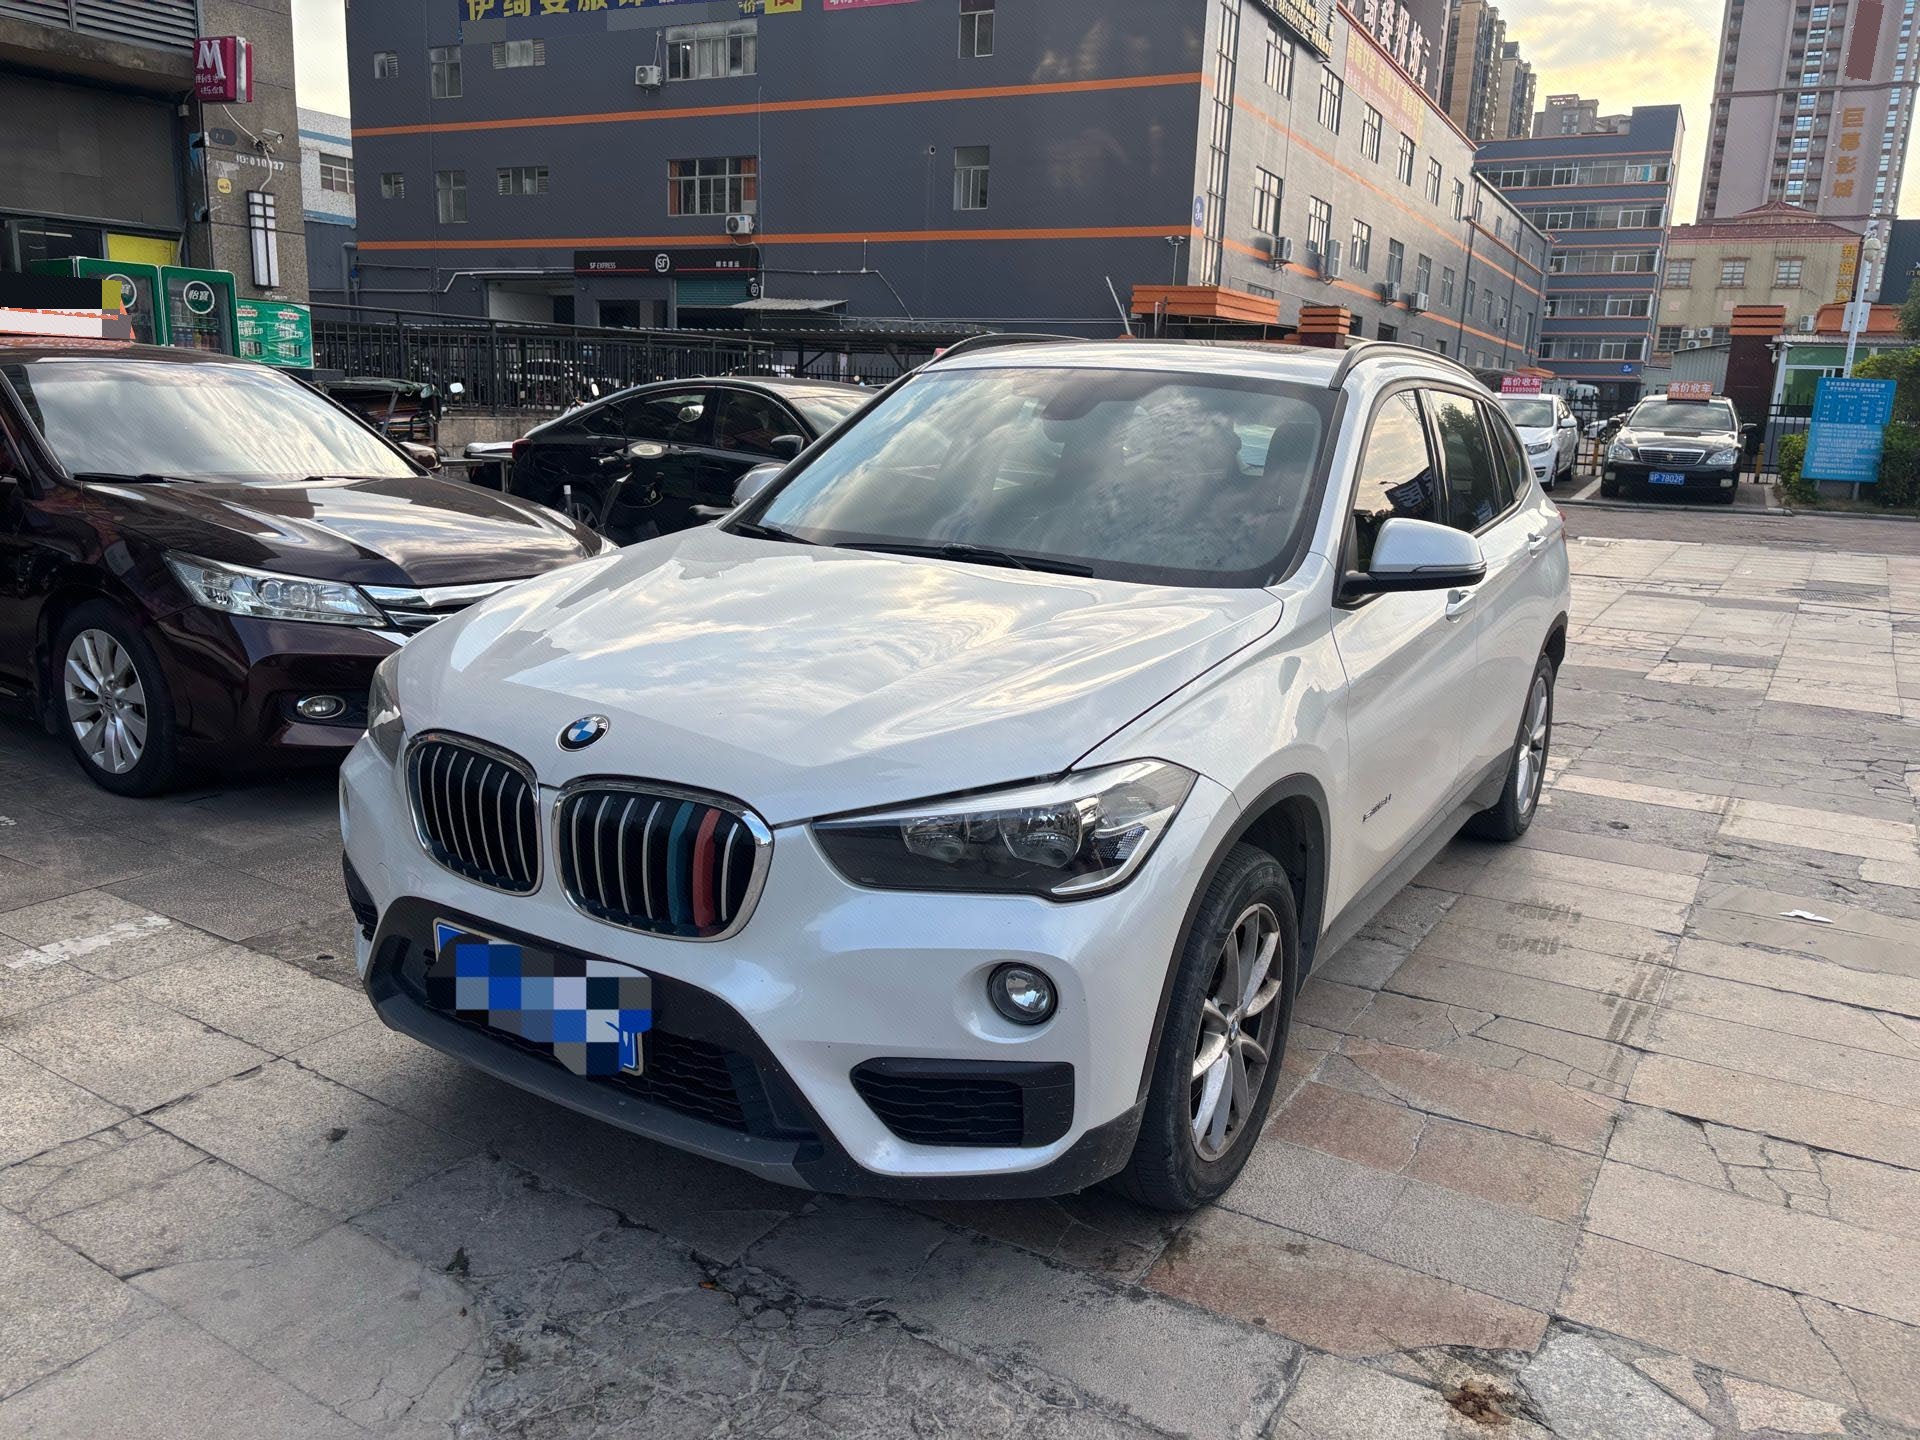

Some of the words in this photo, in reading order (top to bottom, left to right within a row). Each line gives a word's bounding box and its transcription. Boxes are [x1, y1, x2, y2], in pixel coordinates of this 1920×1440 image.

[197, 40, 226, 79] M
[236, 154, 284, 171] ID:01037
[1502, 376, 1541, 387] 高价收车
[1669, 382, 1711, 394] 高价收车
